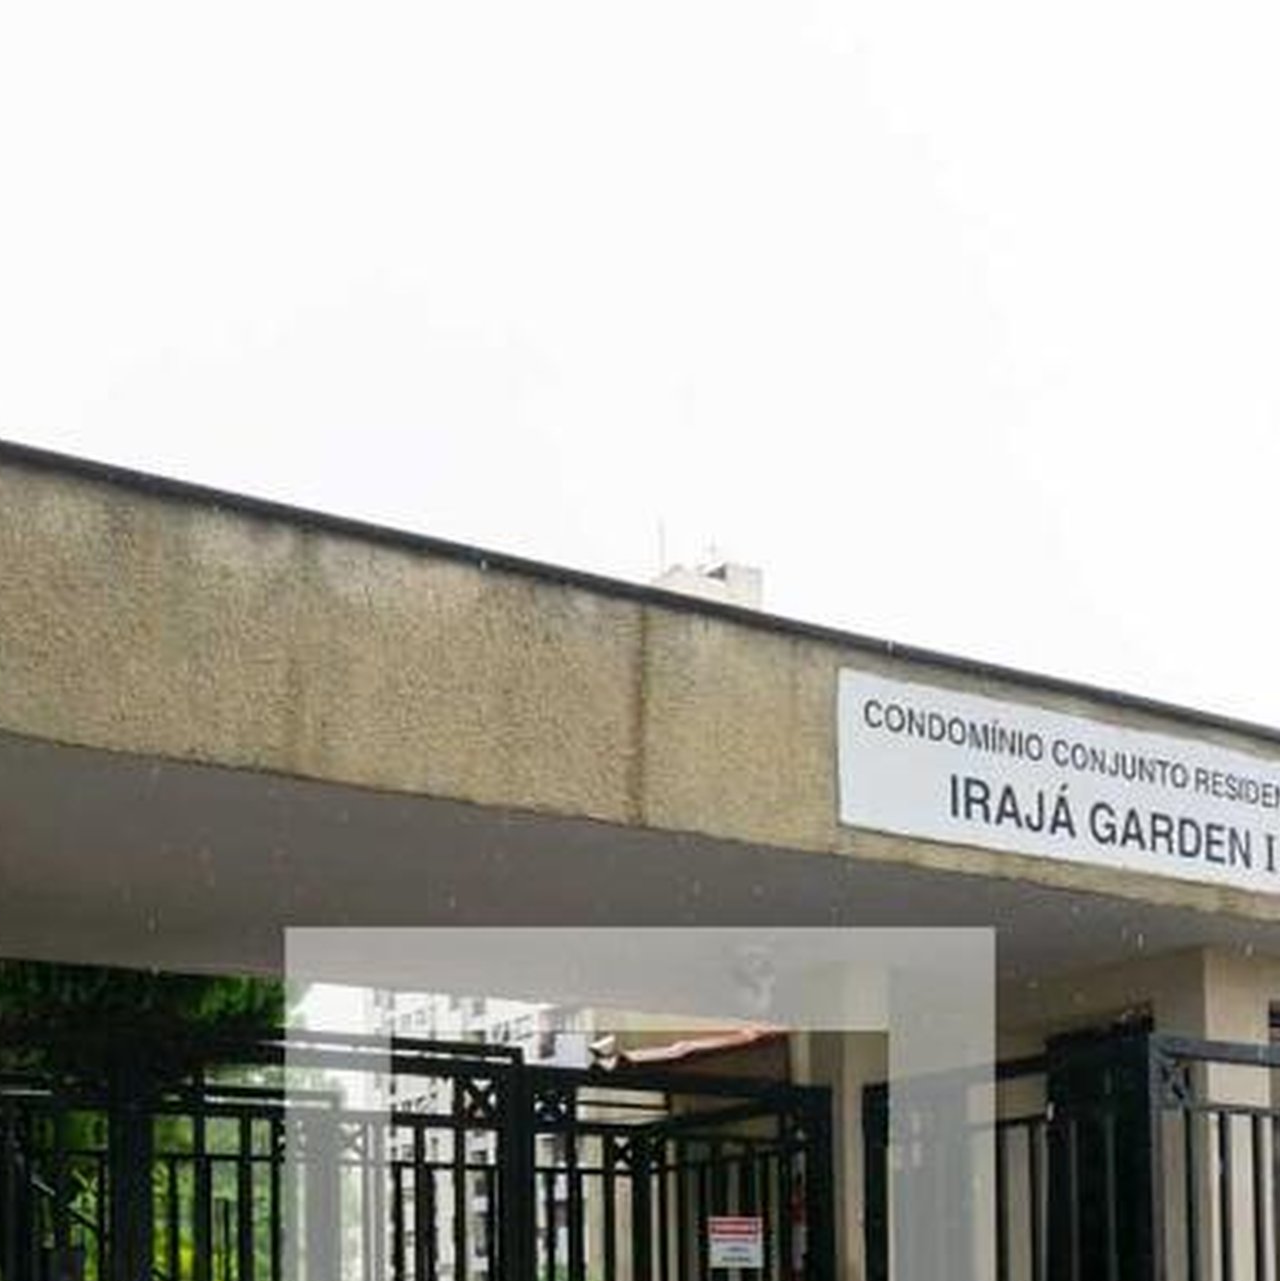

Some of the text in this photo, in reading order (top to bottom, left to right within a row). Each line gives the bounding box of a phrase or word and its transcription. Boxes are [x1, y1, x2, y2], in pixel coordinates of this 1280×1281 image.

[864, 699, 1044, 762] CONDOMÍNIO
[1051, 739, 1190, 789] CONJUNTO
[950, 773, 1277, 873] IRAJÁ GARDEN I
